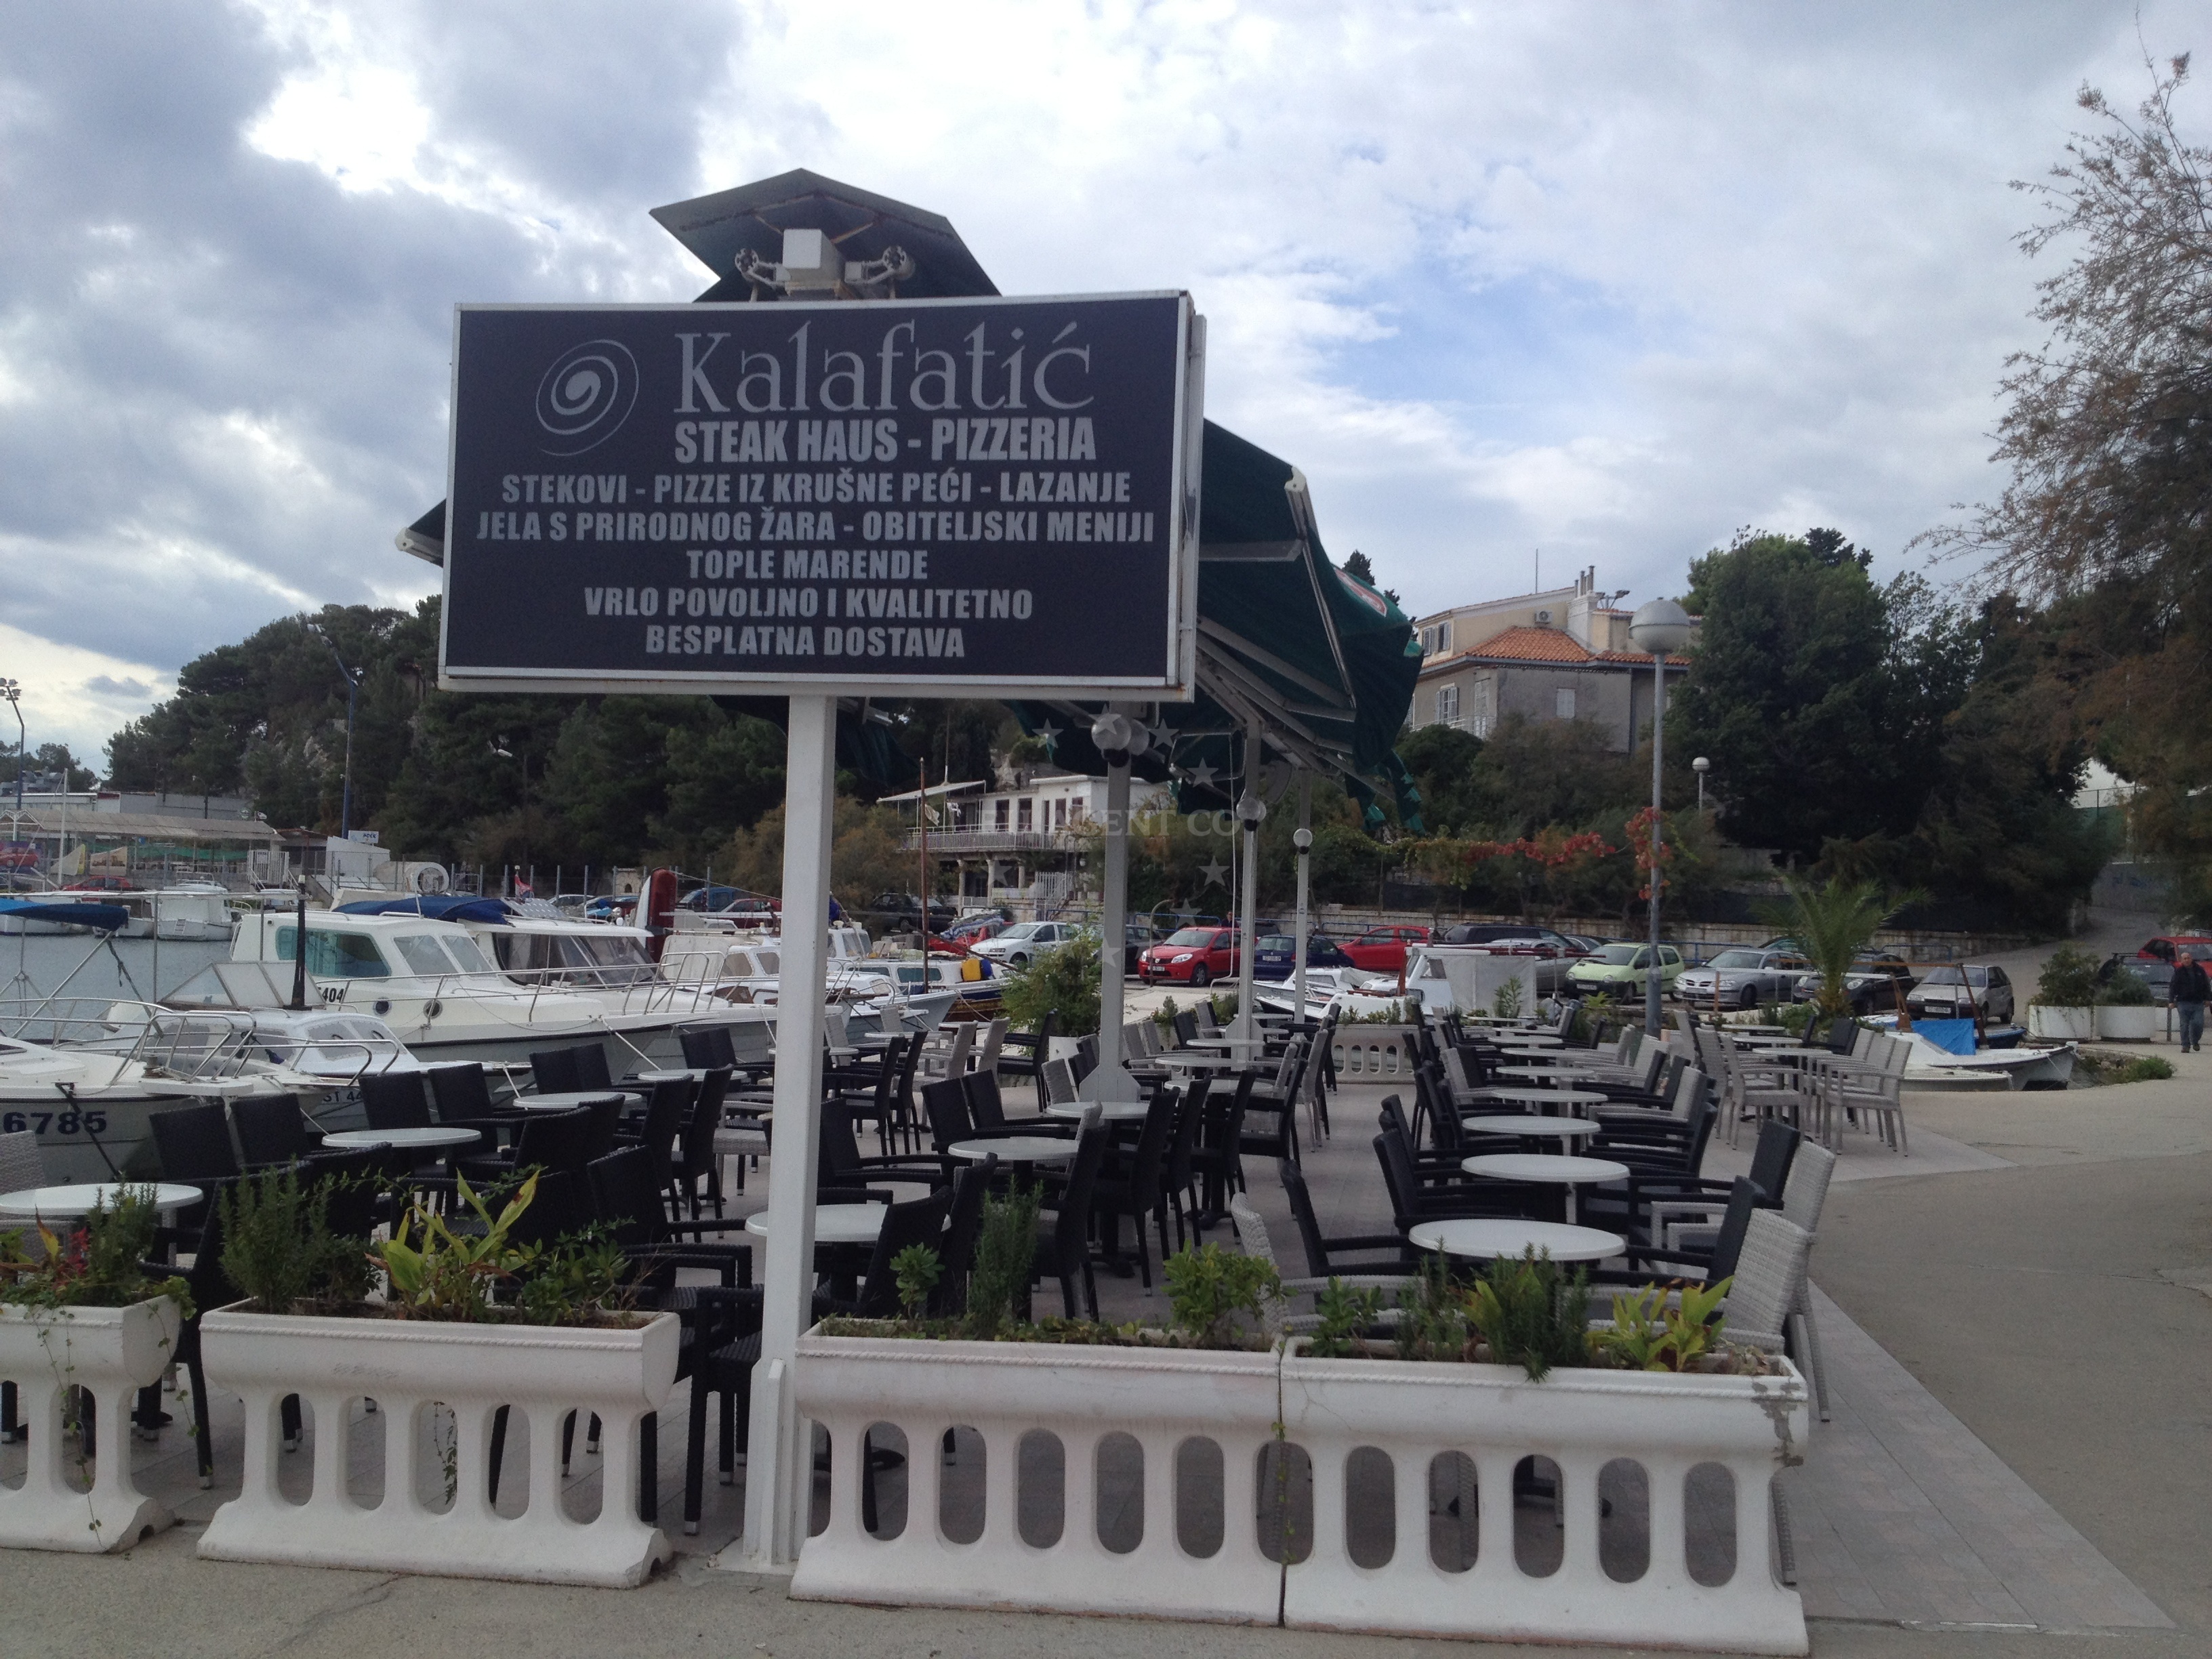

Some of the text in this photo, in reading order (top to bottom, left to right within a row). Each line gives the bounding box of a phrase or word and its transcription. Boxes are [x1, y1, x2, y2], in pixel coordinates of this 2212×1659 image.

[674, 321, 1094, 413] Kalafatić
[675, 417, 1097, 464] STEAK HAUS - PIZZERIA
[502, 474, 627, 504] STEKOVI
[654, 474, 731, 503] PIZZE
[739, 473, 765, 503] IZ
[773, 468, 893, 503] KRUŠNE
[902, 467, 972, 503] PEĆI
[1000, 472, 1130, 503] LAZANJE
[476, 512, 541, 540] JELA
[550, 512, 567, 541] S
[576, 511, 752, 541] PRIRODNOG
[759, 506, 836, 541] ŽARA
[863, 510, 1038, 541] OBITELJSKI
[1047, 511, 1154, 542] MENIJI
[686, 550, 928, 579] TOPLE MARENDE
[584, 587, 1032, 619] VRLO POVOLJNO I KVALITETNO
[646, 625, 964, 657] BESPLATNA DOSTAVA
[3, 1111, 107, 1134] 6785
